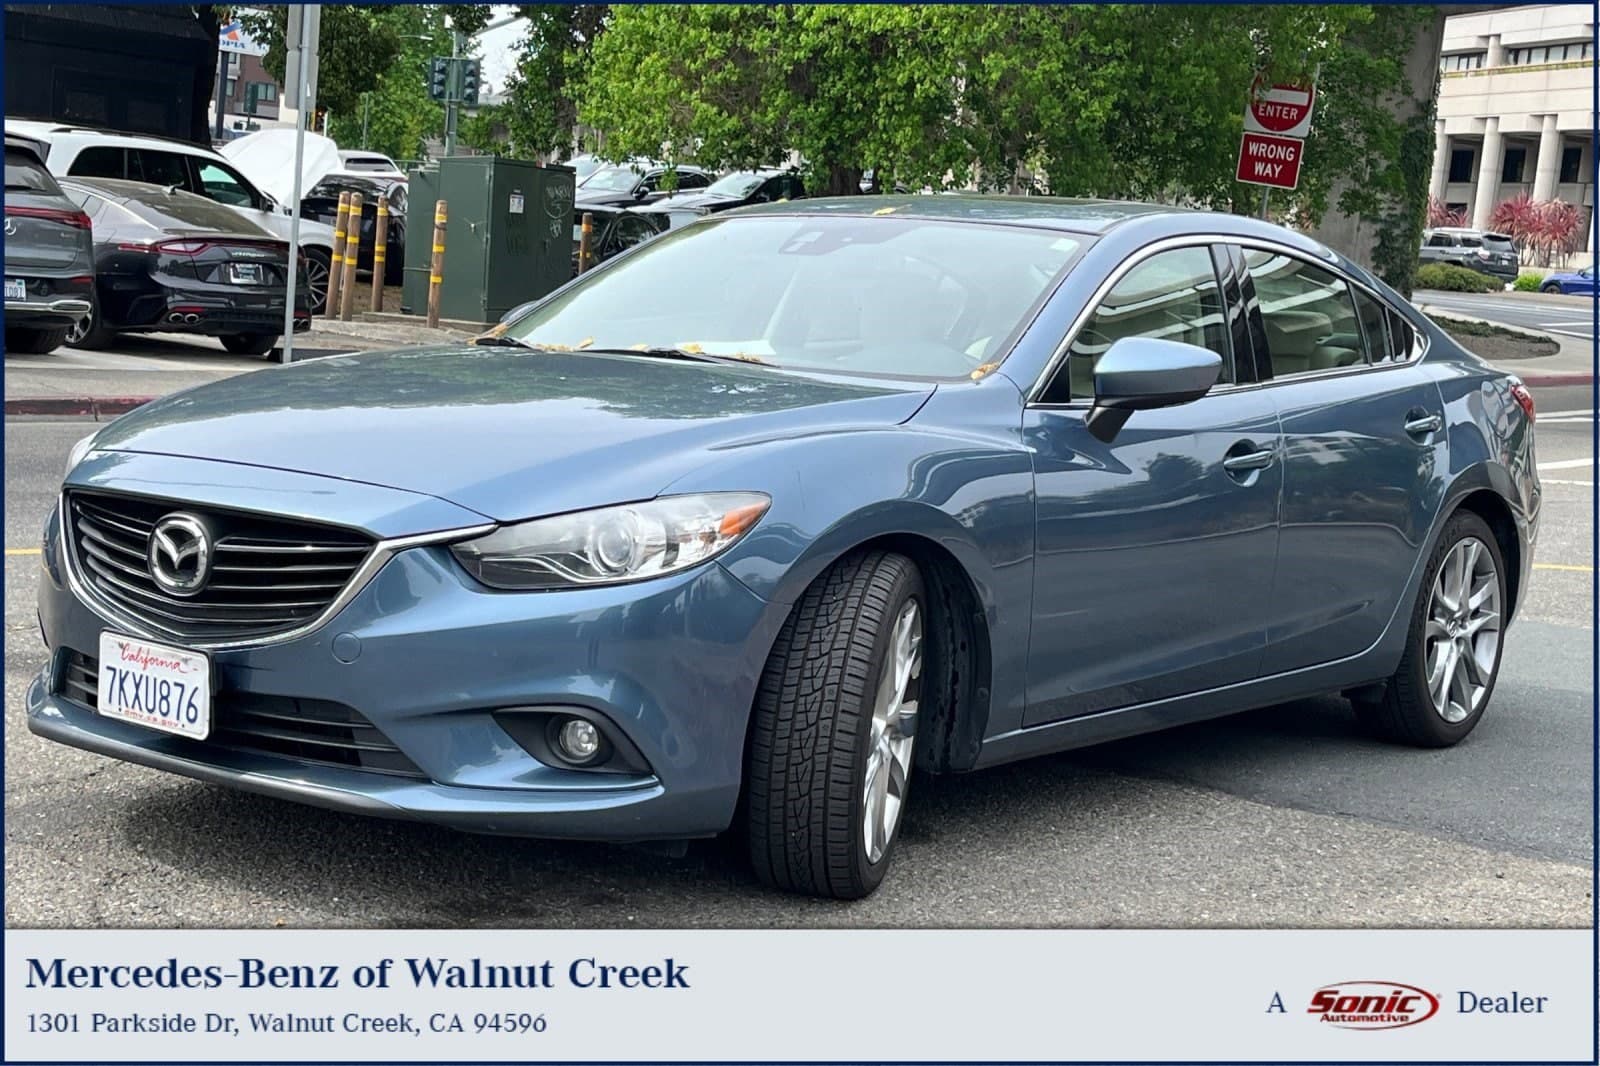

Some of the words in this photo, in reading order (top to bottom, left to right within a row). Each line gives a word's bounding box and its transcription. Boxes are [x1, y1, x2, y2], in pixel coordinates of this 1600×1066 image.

[1258, 105, 1298, 120] ENTER
[1249, 142, 1295, 161] WRONG
[1254, 162, 1283, 178] WAY
[121, 643, 188, 673] California
[106, 666, 198, 724] 7KXU876
